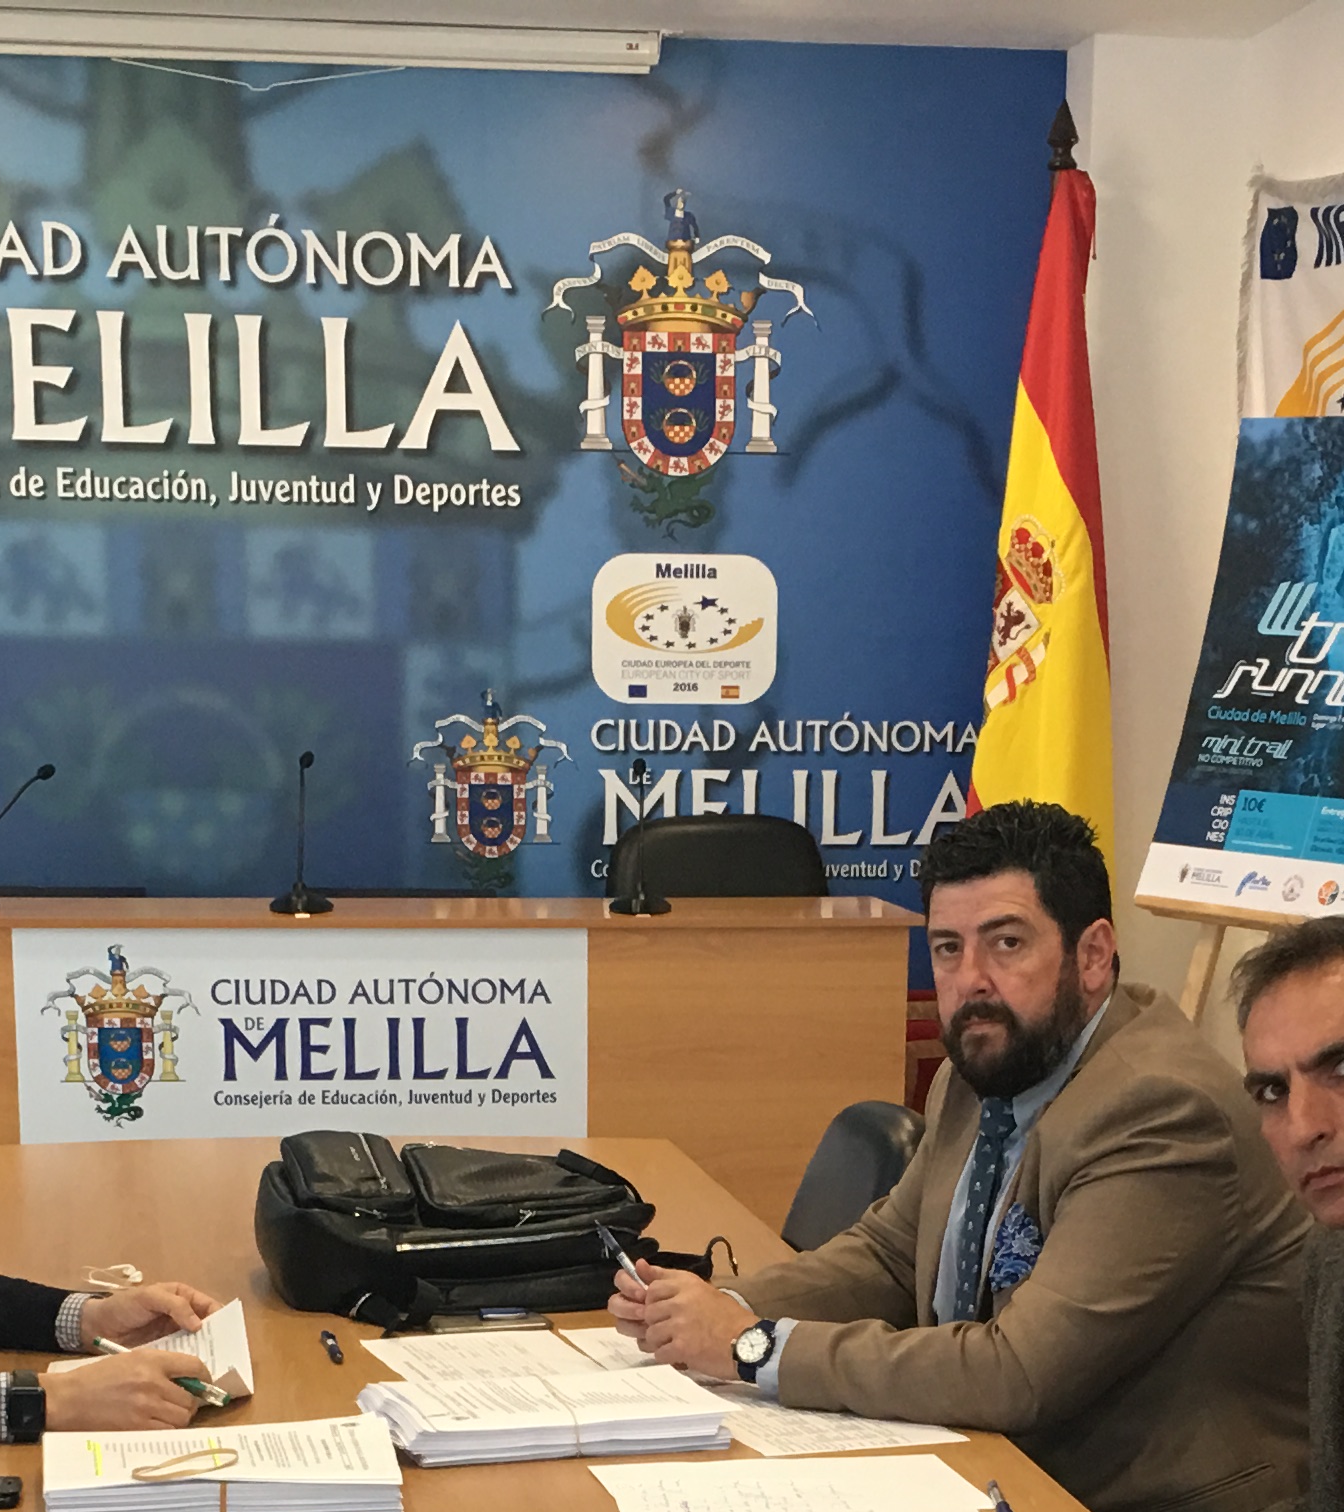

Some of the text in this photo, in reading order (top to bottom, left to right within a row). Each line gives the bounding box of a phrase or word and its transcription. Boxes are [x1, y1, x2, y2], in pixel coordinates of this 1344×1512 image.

[106, 214, 512, 289] AUTÓNOMA
[10, 467, 44, 498] de
[57, 467, 216, 507] Educación,
[228, 471, 354, 505] Juventud
[366, 480, 383, 510] y
[393, 475, 522, 511] Deportes
[656, 563, 717, 579] Melilla
[621, 660, 653, 668] CIUDAD
[655, 660, 694, 668] EUROPEA
[713, 661, 751, 669] DEPORTE
[673, 682, 698, 692] 2016
[1208, 706, 1307, 726] Ciudad de Melilla
[590, 712, 978, 752] CIUDAD AUTÓNOMA
[1202, 734, 1293, 759] mini trail
[1198, 754, 1263, 768] NO COMPETITIVO
[1220, 794, 1236, 806] INS
[1241, 797, 1266, 813] 10€
[1211, 806, 1233, 817] CRIP
[1212, 819, 1228, 830] CIO
[1206, 831, 1225, 842] NES
[824, 860, 888, 878] uventud
[893, 865, 903, 881] y
[211, 972, 551, 1005] CIUDAD AUTÓNOMA
[244, 1017, 264, 1031] DE
[218, 1017, 557, 1081] MELILLA
[214, 1088, 557, 1107] Consejería de Educación, Juventud y Deportes
